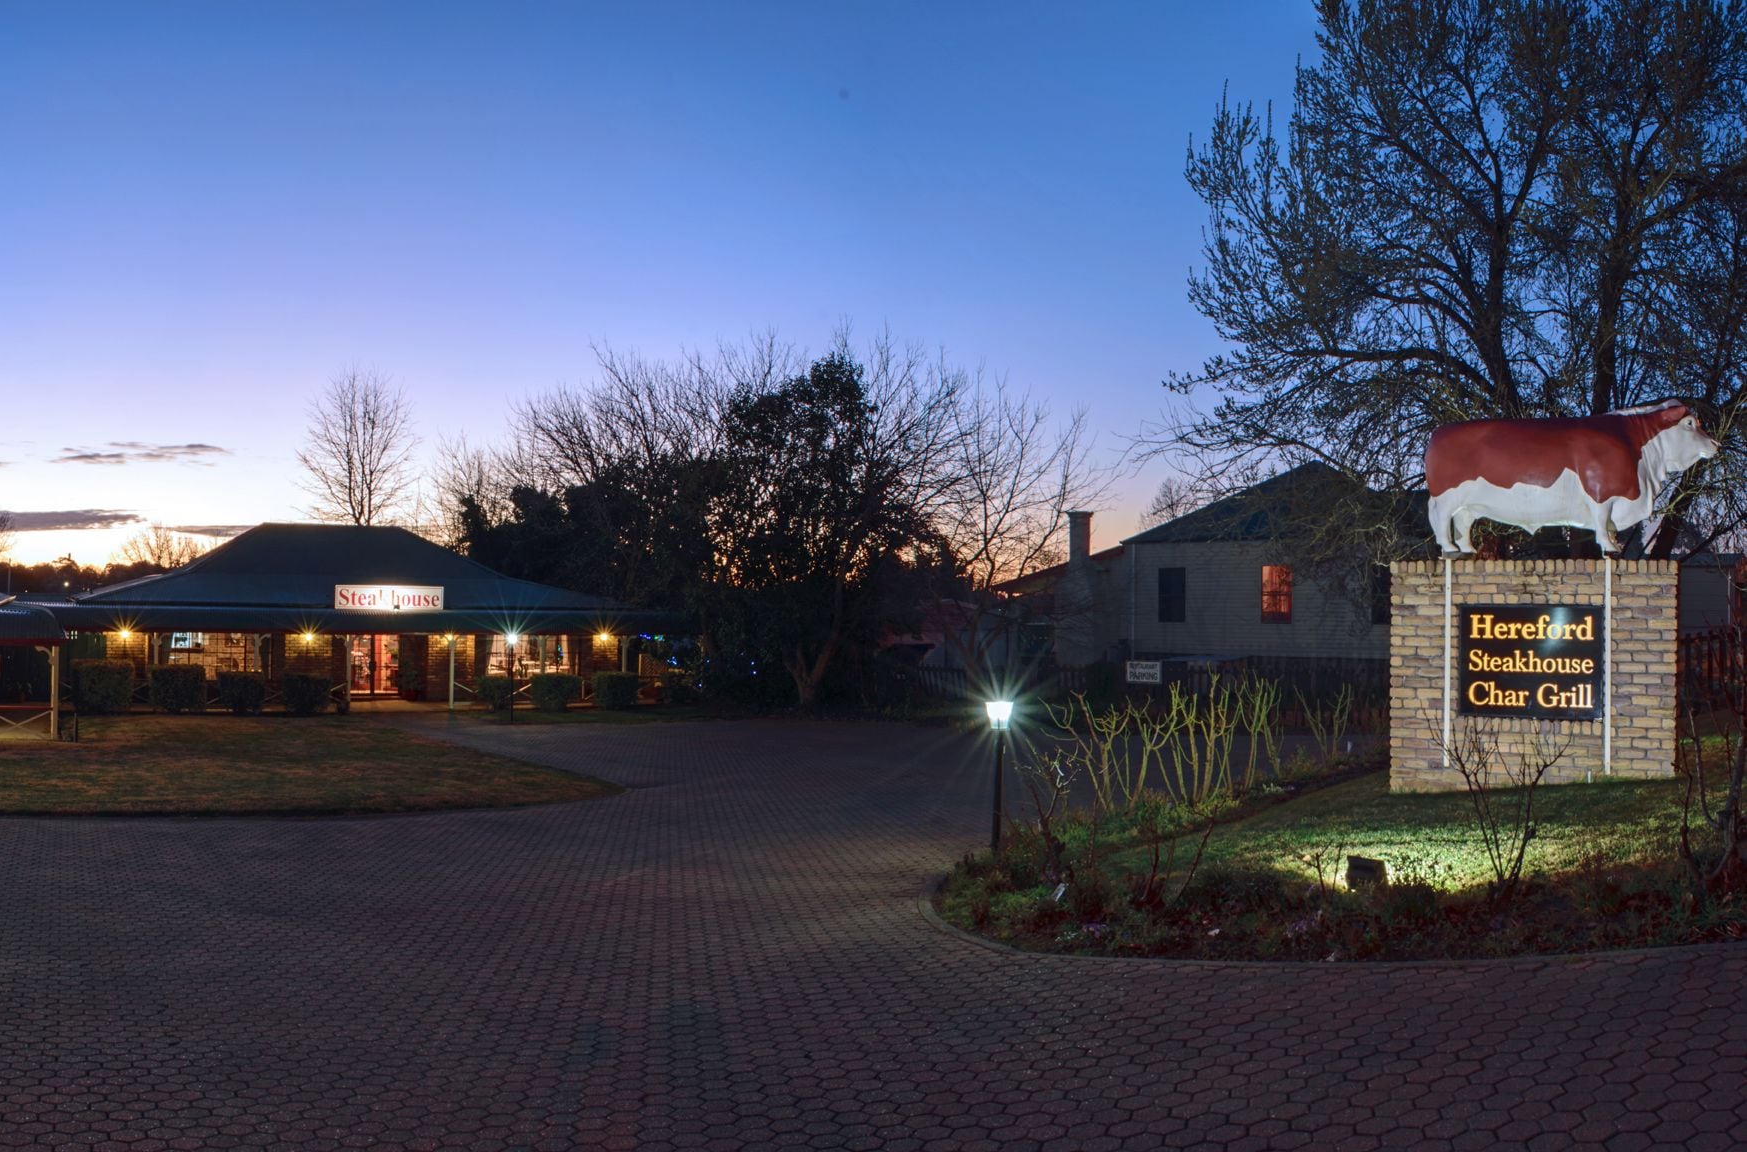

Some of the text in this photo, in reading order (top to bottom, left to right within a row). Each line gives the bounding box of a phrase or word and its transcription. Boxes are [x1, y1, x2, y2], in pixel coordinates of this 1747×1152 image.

[338, 588, 440, 607] Steahouse
[1469, 613, 1594, 641] Hereford
[1468, 649, 1594, 674] Steakhouse
[1129, 671, 1158, 681] PARKING
[1468, 681, 1594, 708] Char Grill
